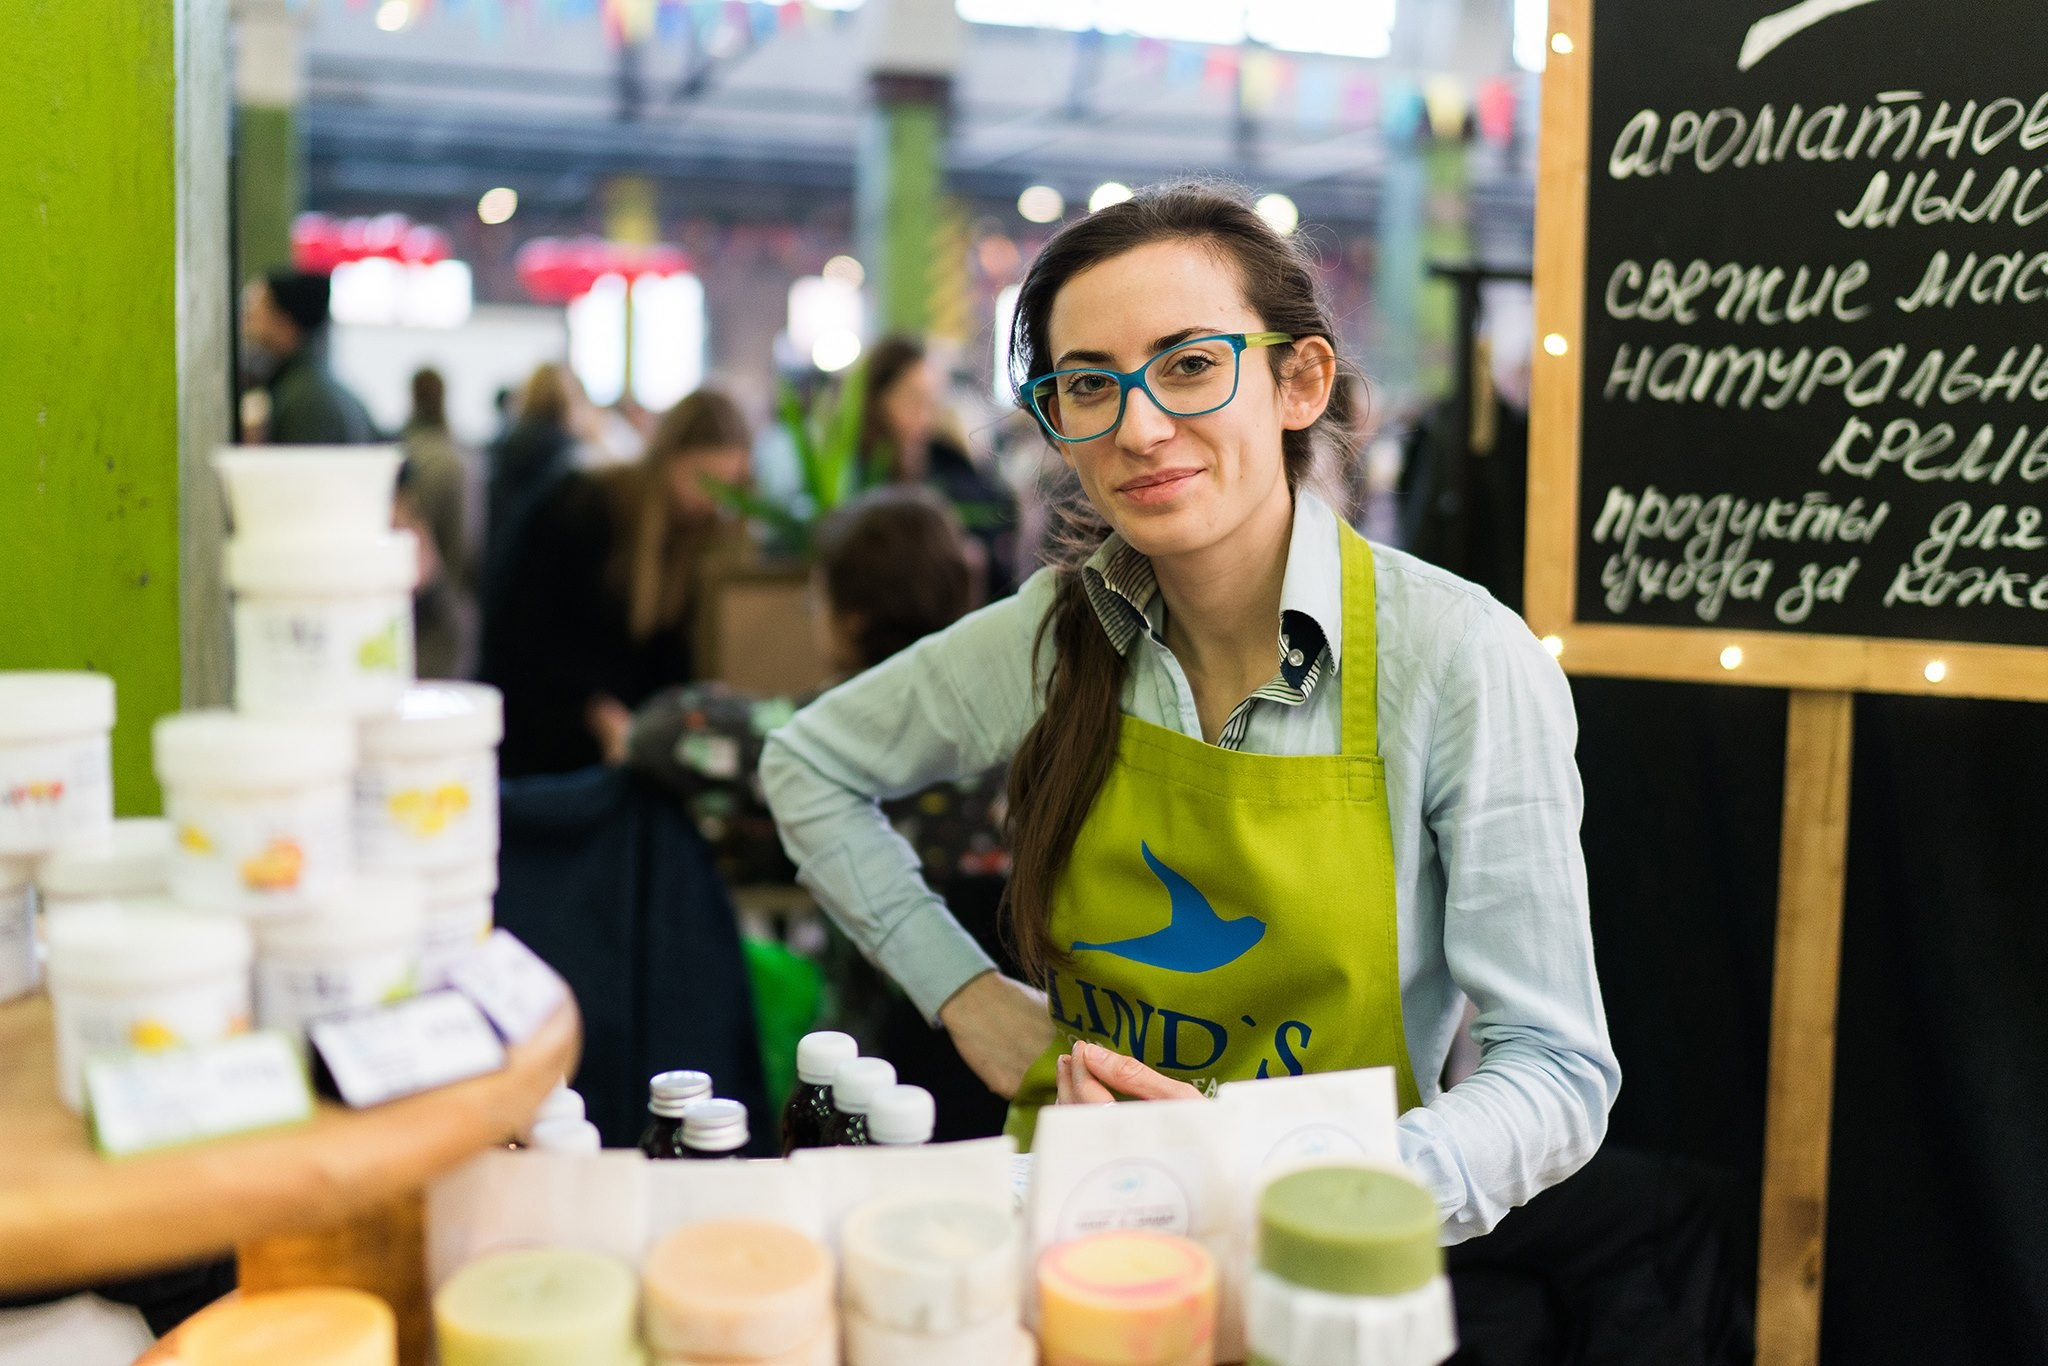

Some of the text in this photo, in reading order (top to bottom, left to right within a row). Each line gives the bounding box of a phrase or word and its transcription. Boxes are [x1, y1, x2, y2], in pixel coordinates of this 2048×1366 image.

[1605, 250, 2048, 324] свежие мас
[1592, 485, 2047, 580] продукты для
[1601, 553, 1776, 622] ухода
[1775, 555, 1860, 624] за
